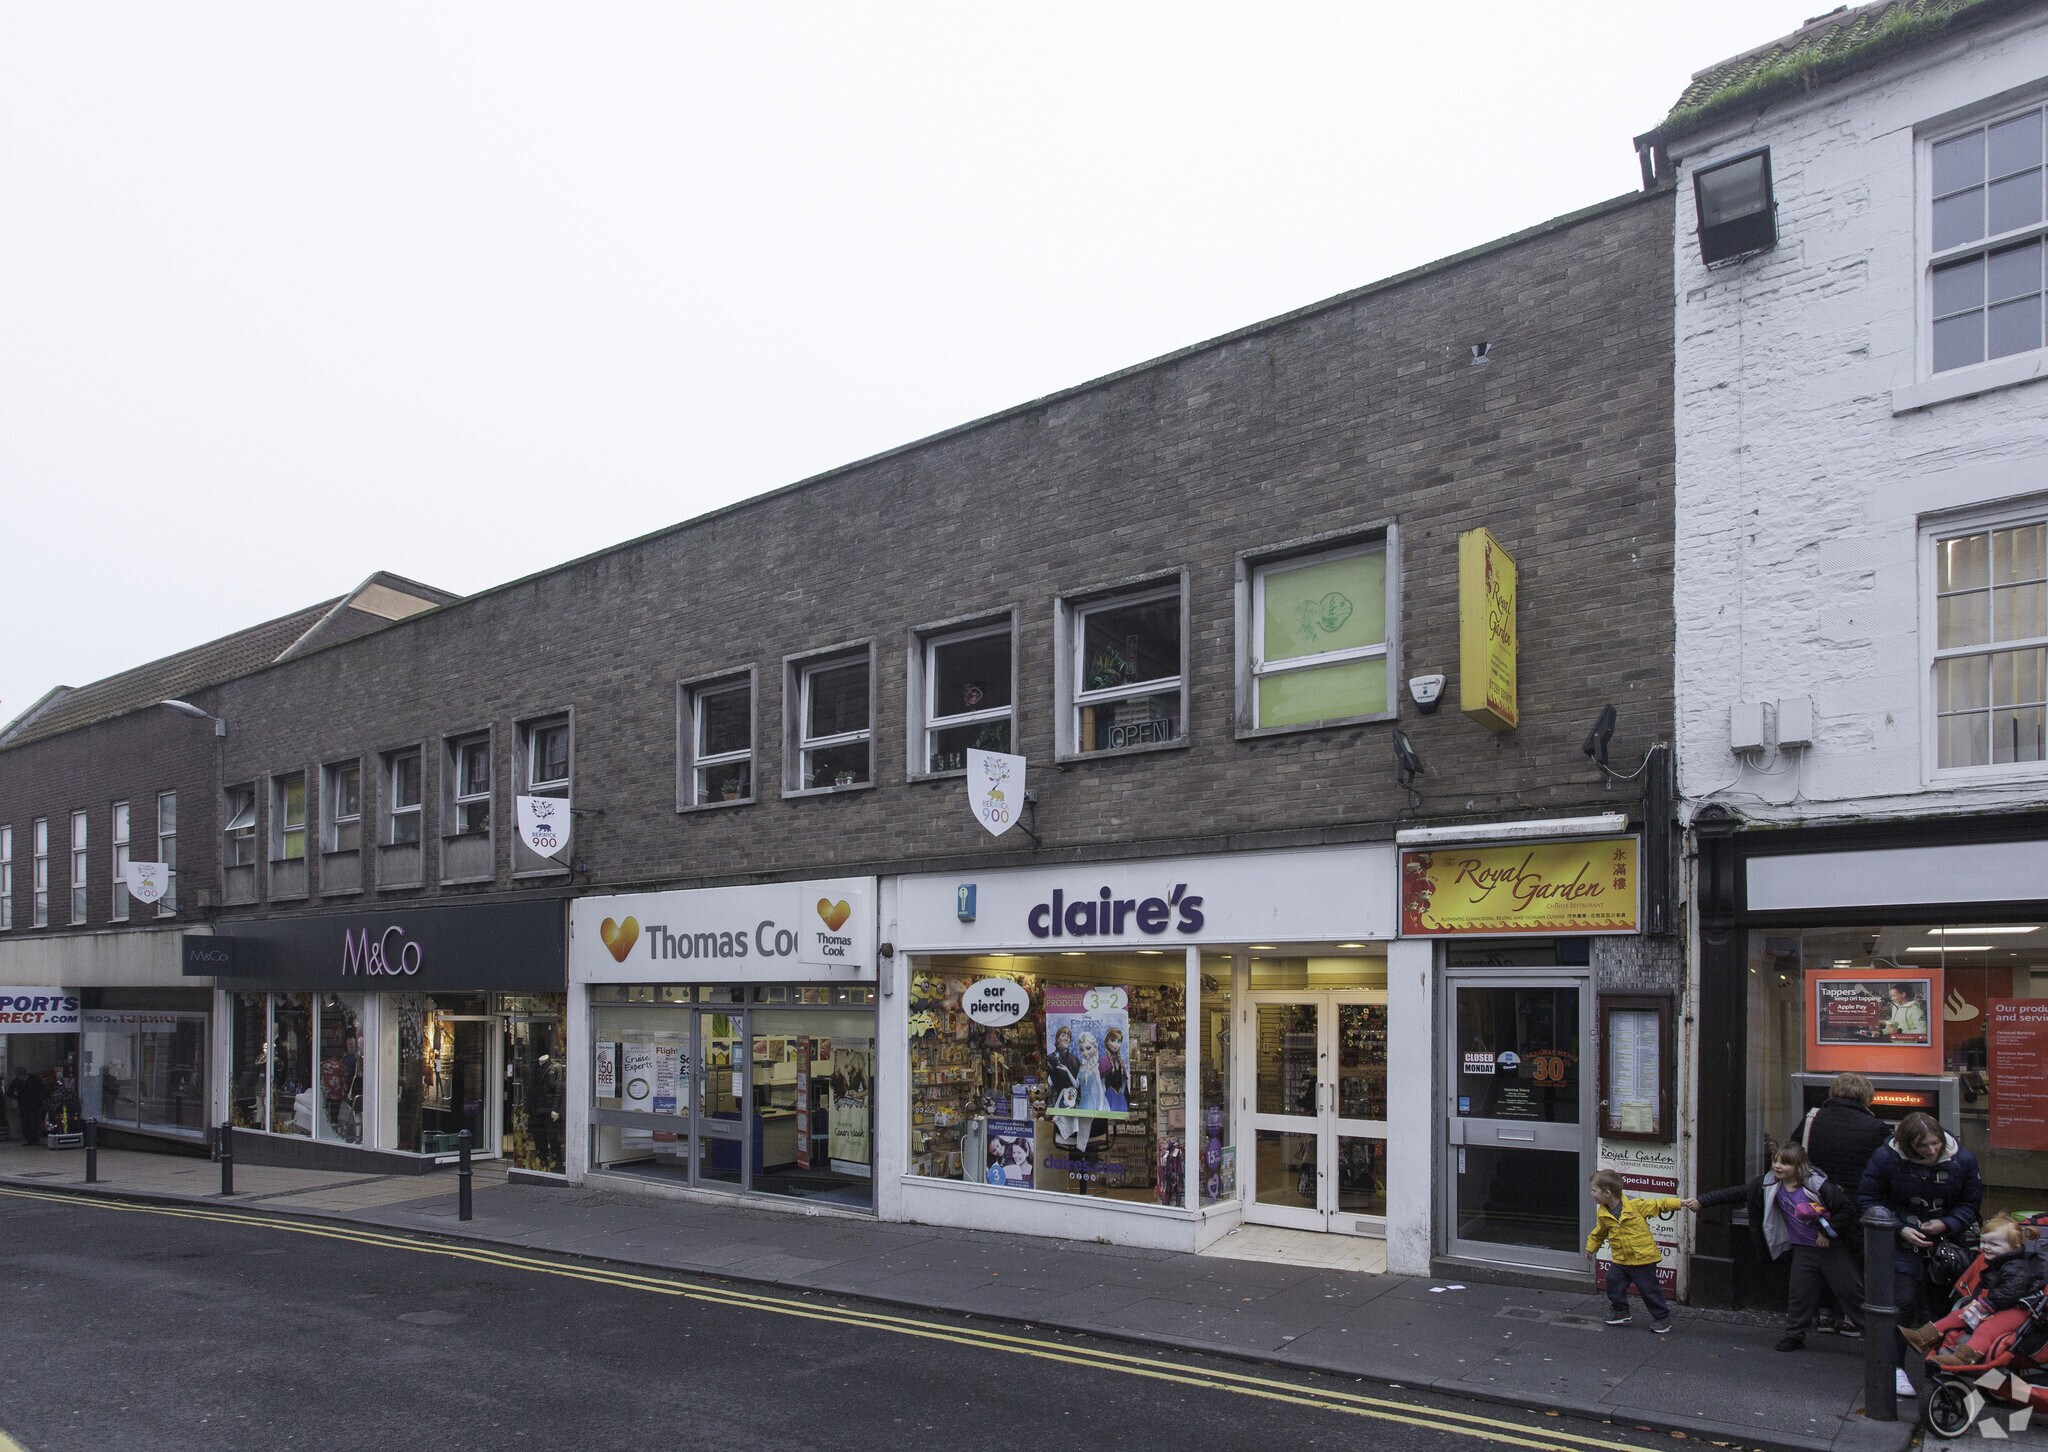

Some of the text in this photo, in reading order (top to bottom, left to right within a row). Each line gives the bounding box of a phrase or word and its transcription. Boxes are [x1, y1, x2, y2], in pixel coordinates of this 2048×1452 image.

[1489, 610, 1513, 646] Garden
[1111, 720, 1166, 748] OPEN
[982, 799, 1009, 809] BERWICK
[982, 807, 1009, 823] 900
[532, 837, 557, 848] 900
[1454, 851, 1534, 903] Royal
[1512, 860, 1605, 912] Garden
[137, 889, 158, 897] 900
[1028, 883, 1205, 938] claire's
[645, 920, 799, 960] Thomas Co
[816, 932, 852, 946] Thomas
[190, 950, 229, 962] M&Co
[342, 925, 424, 976] M&Co
[822, 945, 845, 957] Cook
[983, 987, 1006, 997] ear
[1820, 987, 1857, 997] Tappers
[0, 996, 79, 1012] PORTS
[1046, 999, 1083, 1007] PRODUCT
[1090, 993, 1099, 1010] 3
[1109, 993, 1119, 1009] 2
[1834, 995, 1849, 1003] keep
[1858, 995, 1882, 1003] tapping
[970, 999, 1020, 1016] piercing
[1995, 1004, 2017, 1012] Our
[1995, 1014, 2017, 1022] and
[1070, 1019, 1104, 1030] FROZEN
[625, 1055, 651, 1064] Cruise
[1464, 1053, 1494, 1062] CLOSED
[624, 1061, 653, 1073] Experts
[1464, 1064, 1494, 1073] MONDAY
[598, 1074, 613, 1085] FREE
[1600, 1148, 1675, 1163] Royal Garden
[1641, 1163, 1675, 1171] RESTAURANT
[992, 1168, 1000, 1181] 3
[1621, 1176, 1676, 1188] Special Lunch
